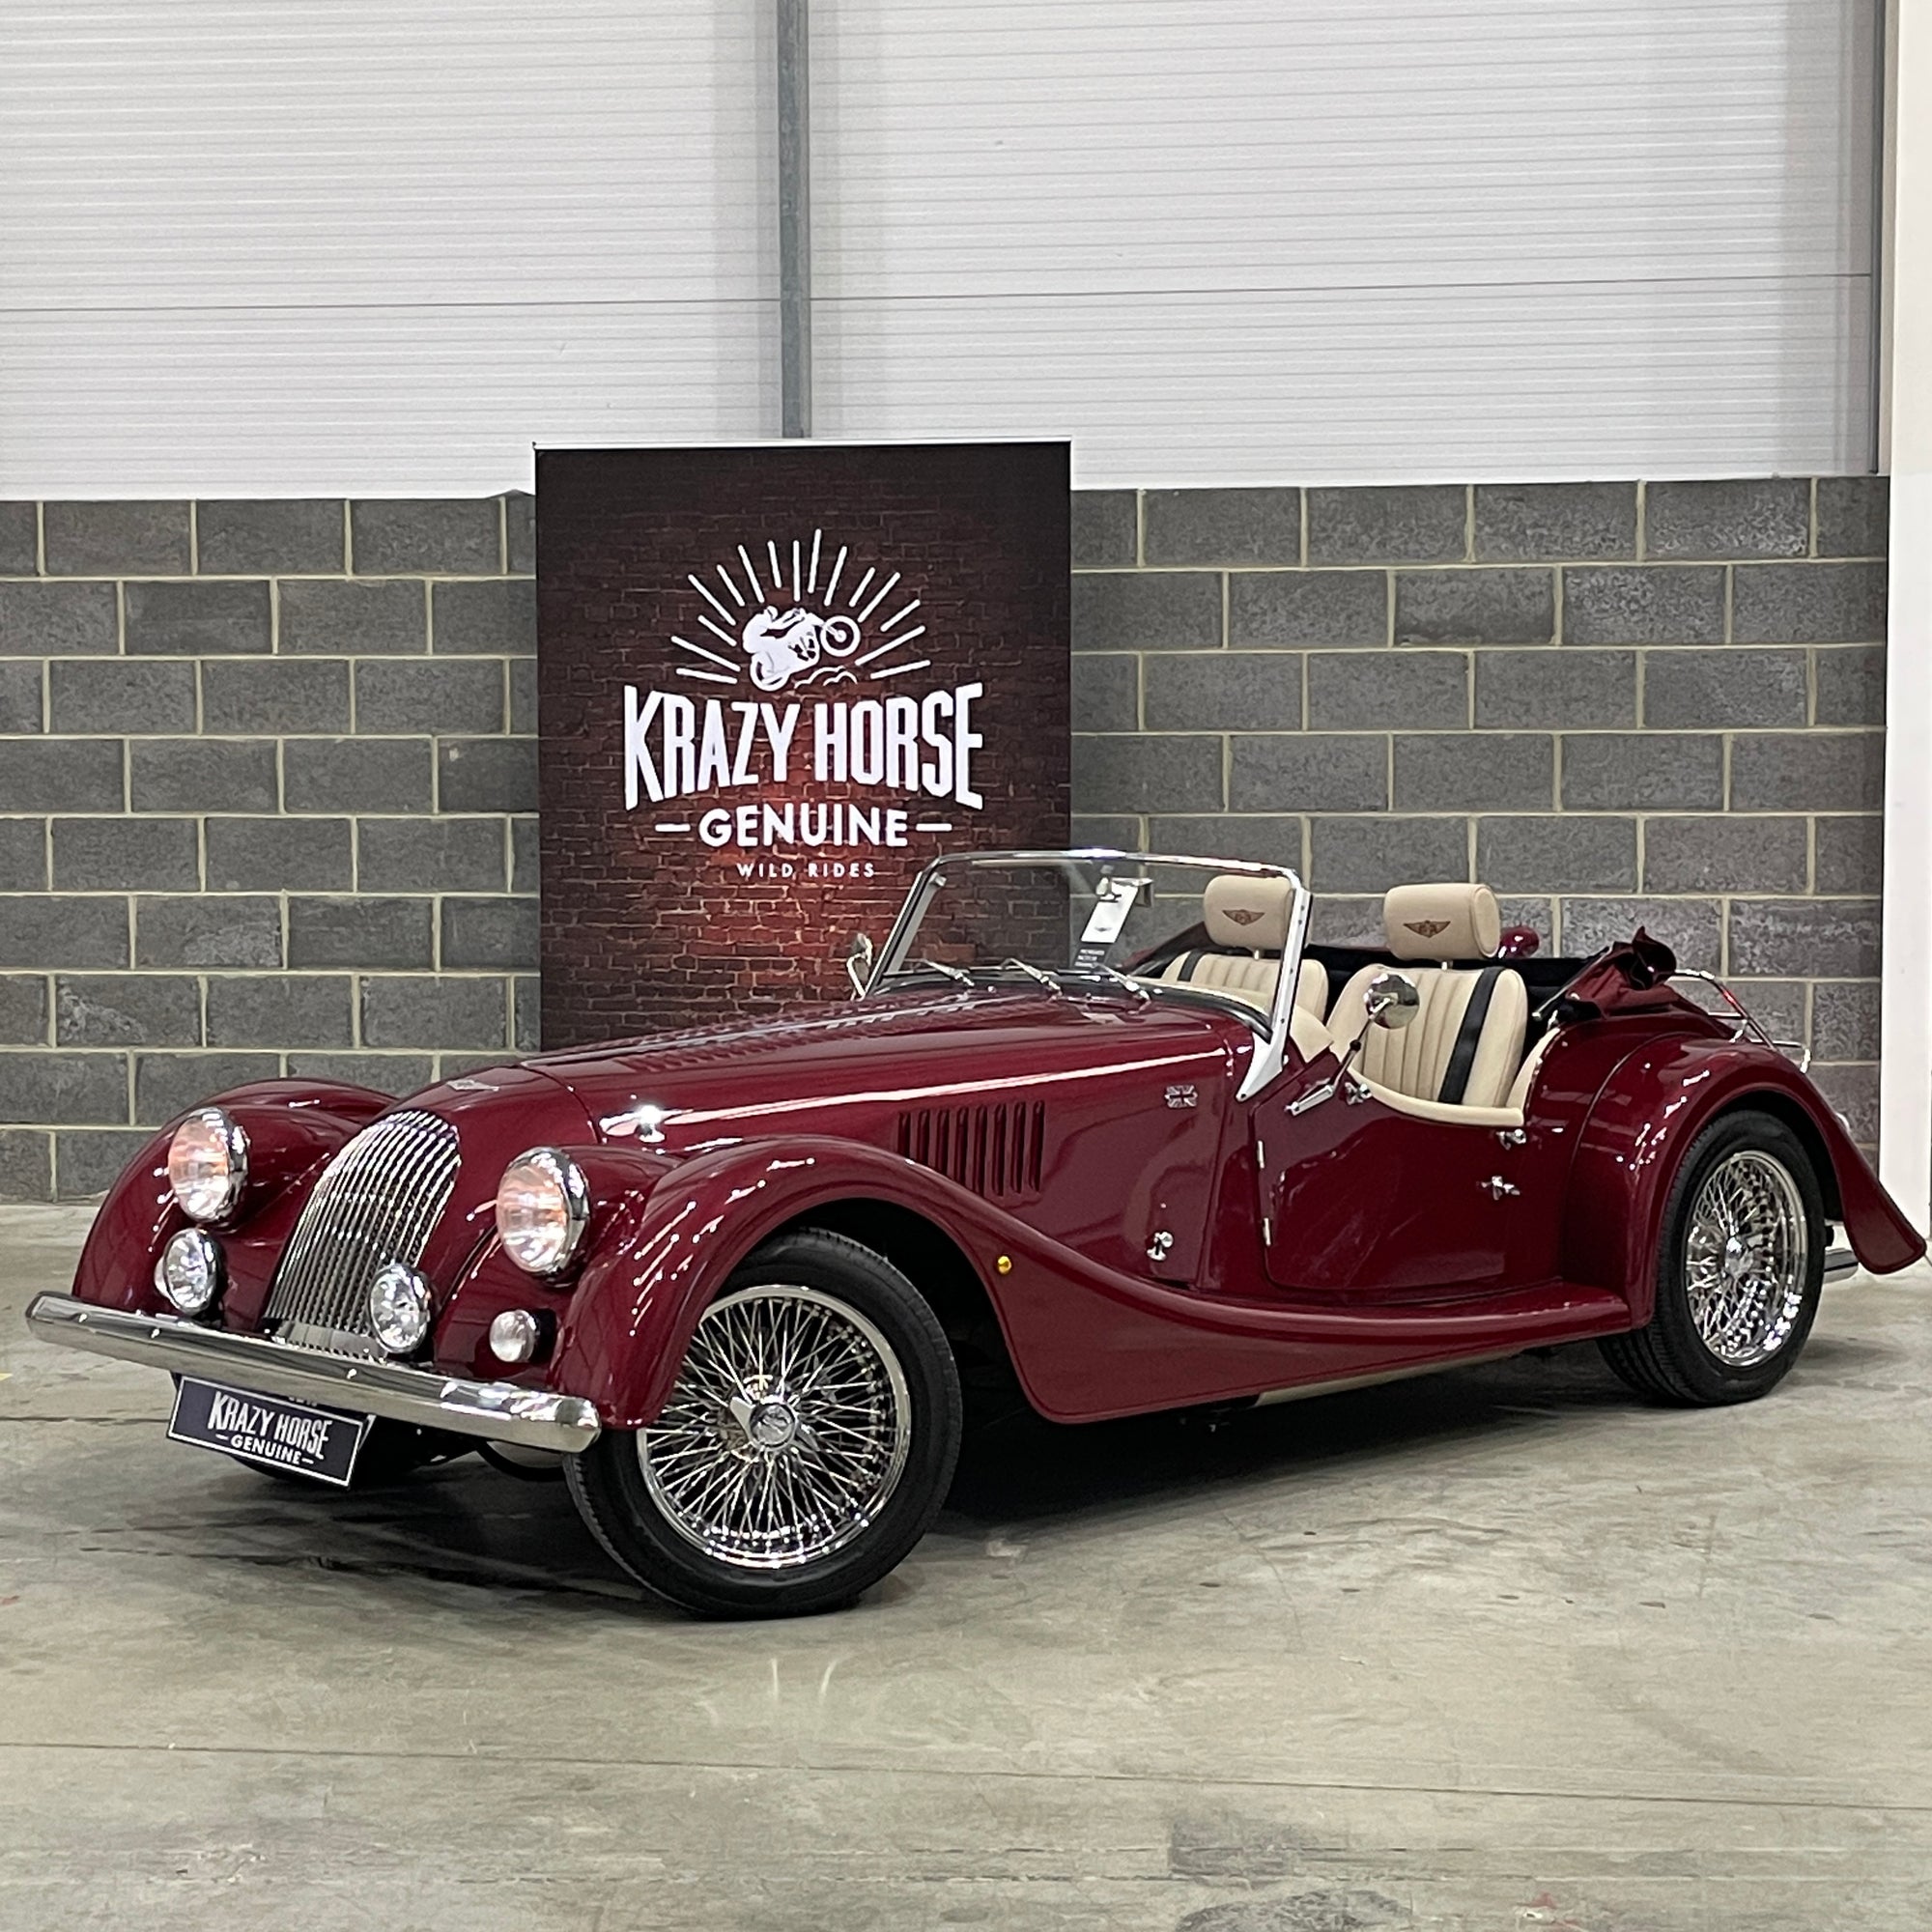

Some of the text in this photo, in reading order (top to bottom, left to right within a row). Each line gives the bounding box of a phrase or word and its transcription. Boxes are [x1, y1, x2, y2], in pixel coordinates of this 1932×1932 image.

[624, 682, 983, 810] KRAZY HORSE
[698, 803, 908, 848] GENUINE
[736, 862, 874, 878] WILD RIDES
[207, 1391, 332, 1460] KRAZY HORSE
[230, 1435, 302, 1464] GENUINE
